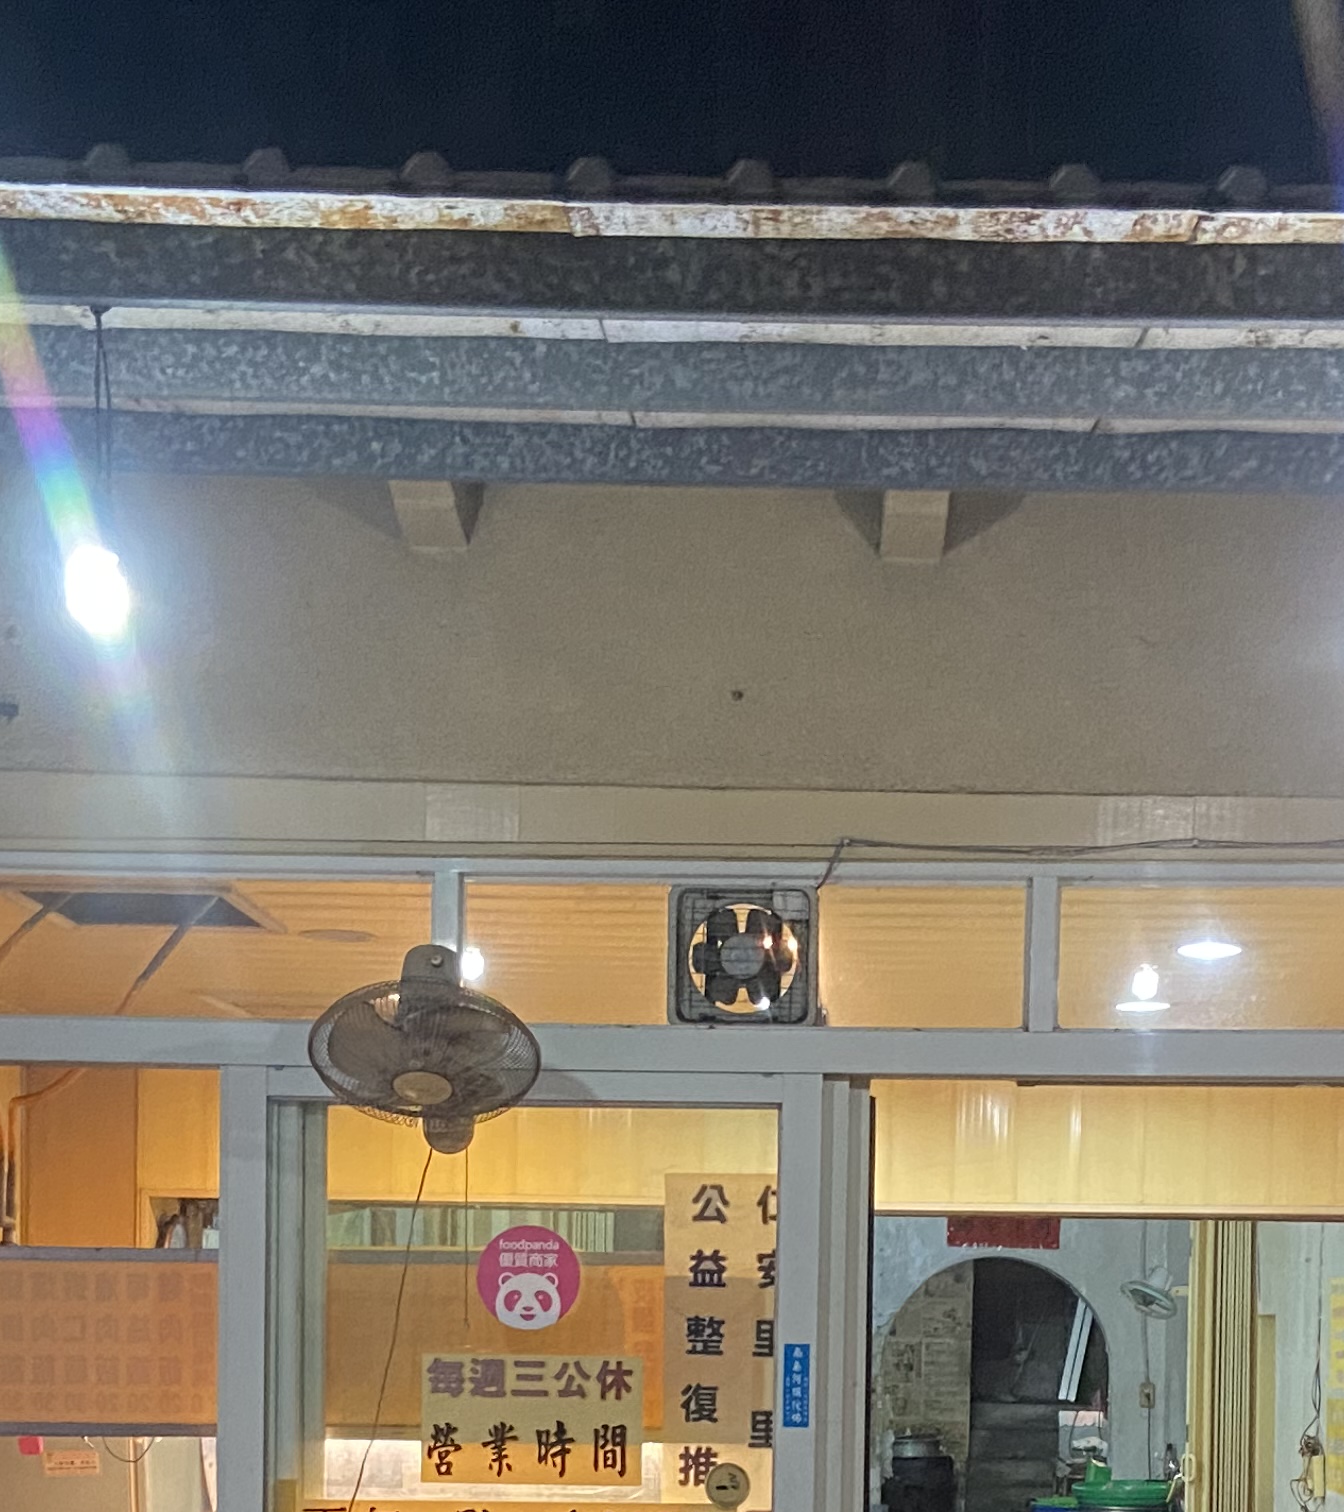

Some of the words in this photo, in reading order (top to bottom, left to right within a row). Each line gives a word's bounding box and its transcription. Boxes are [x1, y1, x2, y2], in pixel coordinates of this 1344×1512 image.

[499, 1239, 559, 1253] foodpanda
[426, 1357, 634, 1400] 每週三公休
[426, 1423, 629, 1479] 營業時間
